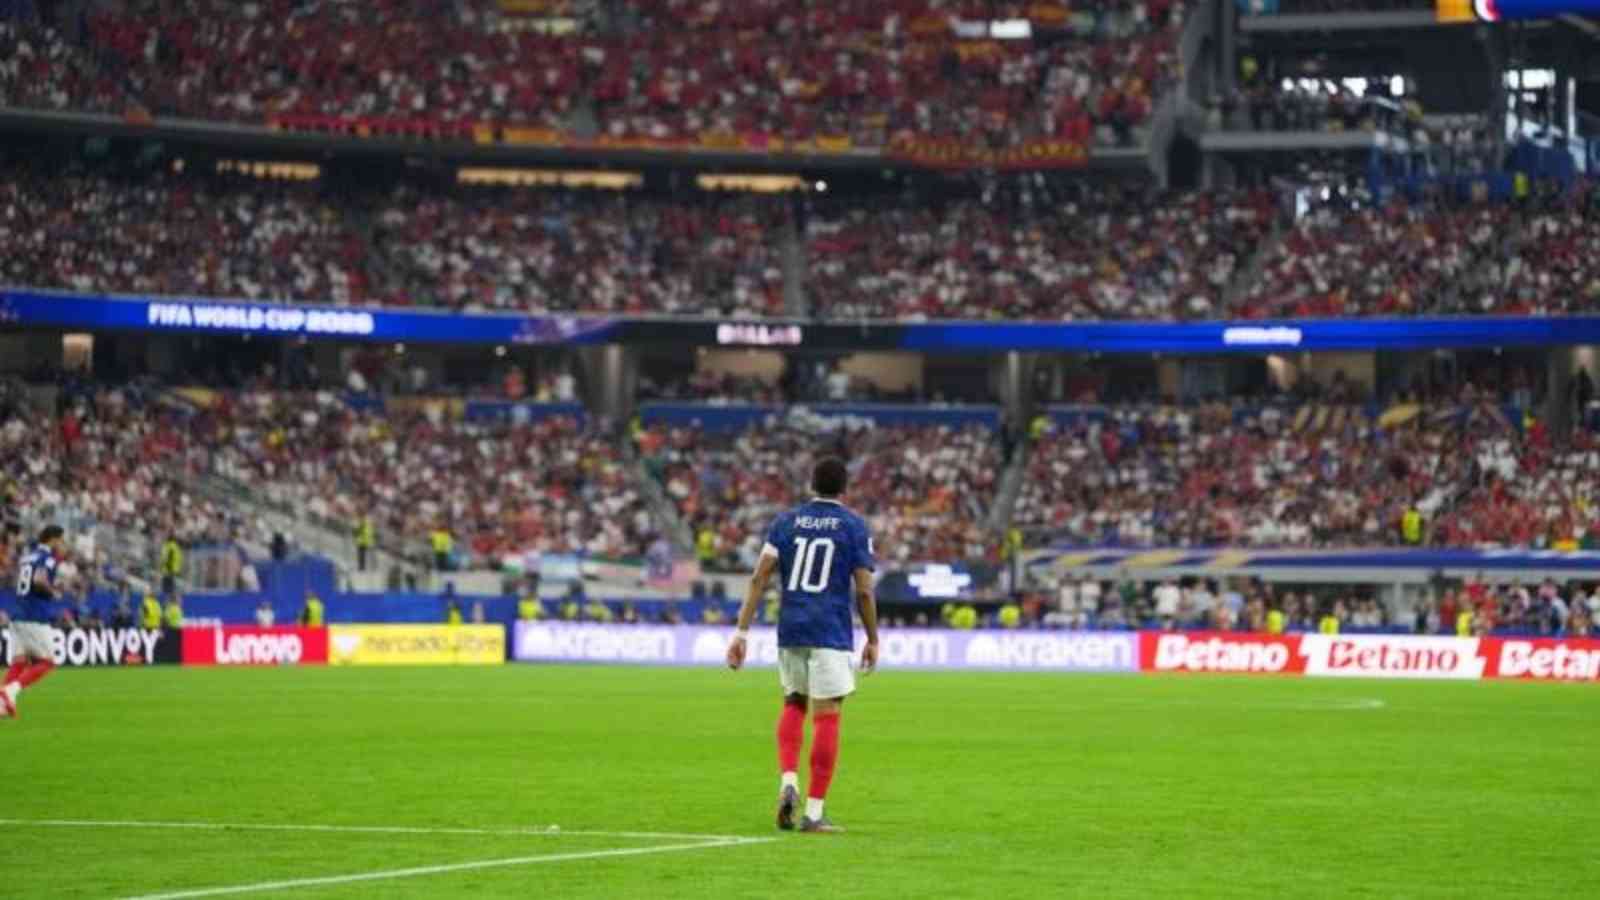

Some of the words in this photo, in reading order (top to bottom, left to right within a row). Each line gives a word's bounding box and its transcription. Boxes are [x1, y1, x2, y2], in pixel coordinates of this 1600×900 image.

[148, 303, 191, 325] FIFA
[193, 305, 264, 329] WORLD
[266, 308, 304, 331] CUP
[787, 537, 834, 593] 10
[214, 617, 303, 664] Lenovo
[550, 628, 675, 659] kraken
[1002, 633, 1131, 667] kraken
[1155, 634, 1289, 671] Betano
[1327, 641, 1458, 671] Betano
